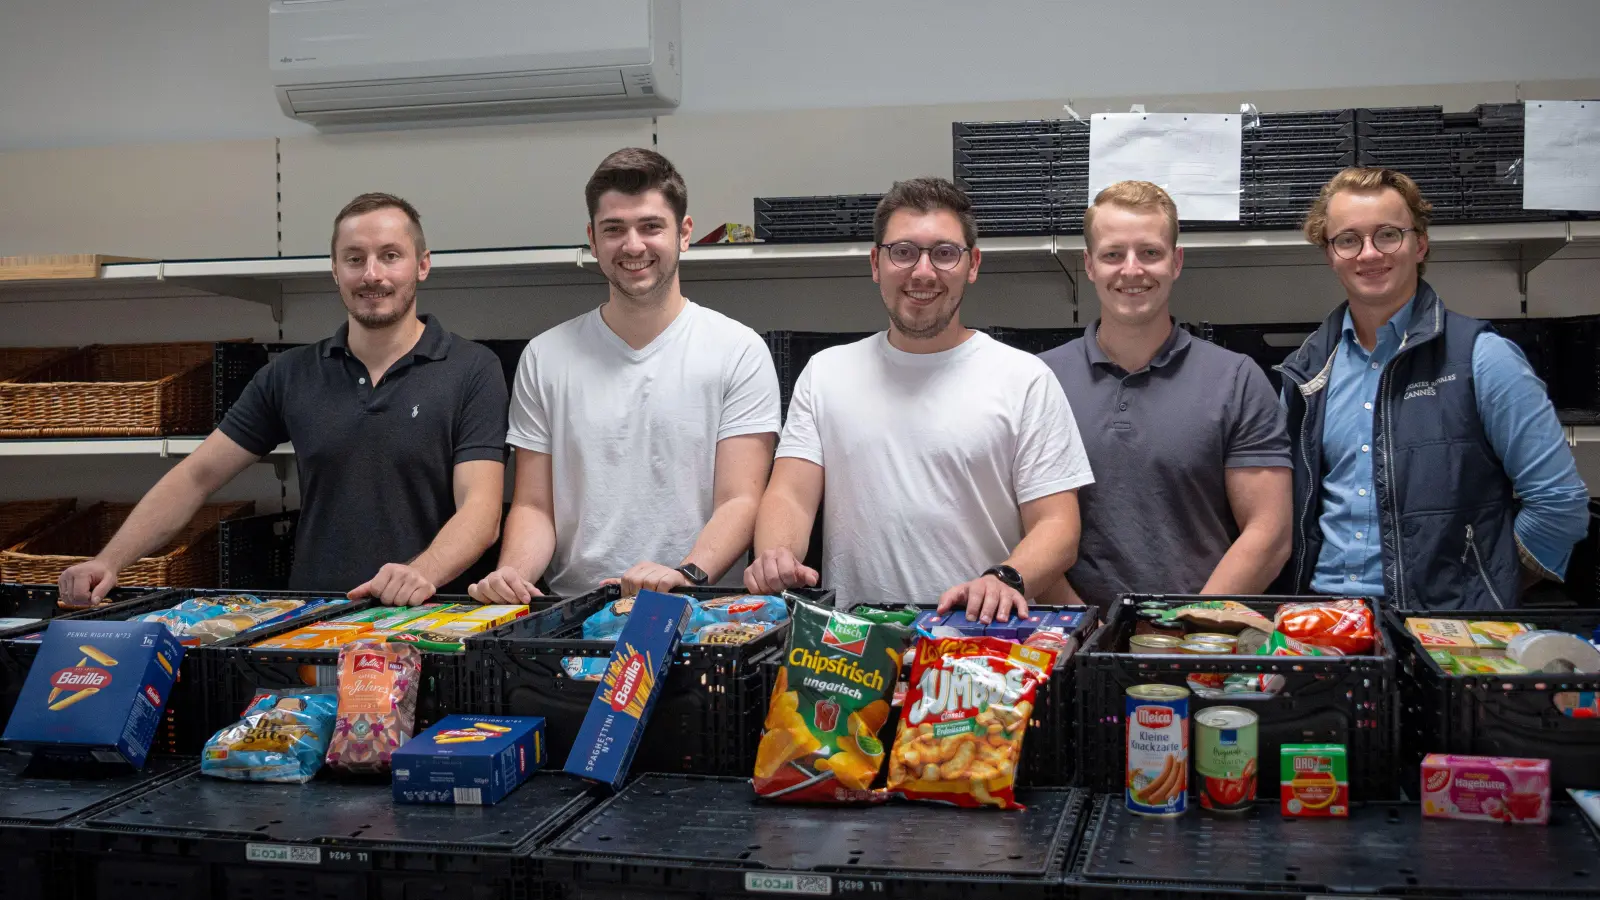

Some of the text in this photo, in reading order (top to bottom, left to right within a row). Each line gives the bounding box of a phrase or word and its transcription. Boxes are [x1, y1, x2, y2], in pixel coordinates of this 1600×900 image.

[1403, 389, 1437, 400] CANNES
[835, 622, 863, 639] frisch
[357, 655, 382, 669] Melitta
[789, 647, 885, 692] Chipsfrisch
[56, 671, 105, 686] Barilla
[614, 658, 642, 706] Barilla
[349, 679, 389, 696] Jahres
[803, 676, 863, 700] ungarisch
[1139, 709, 1171, 722] Meica
[585, 714, 615, 772] SPAGHETTINI
[1139, 731, 1169, 741] Kleine
[1130, 741, 1180, 752] Knackzarte
[1455, 778, 1505, 790] Hagebutte
[261, 849, 288, 859] IFCO
[763, 878, 794, 889] IFCO
